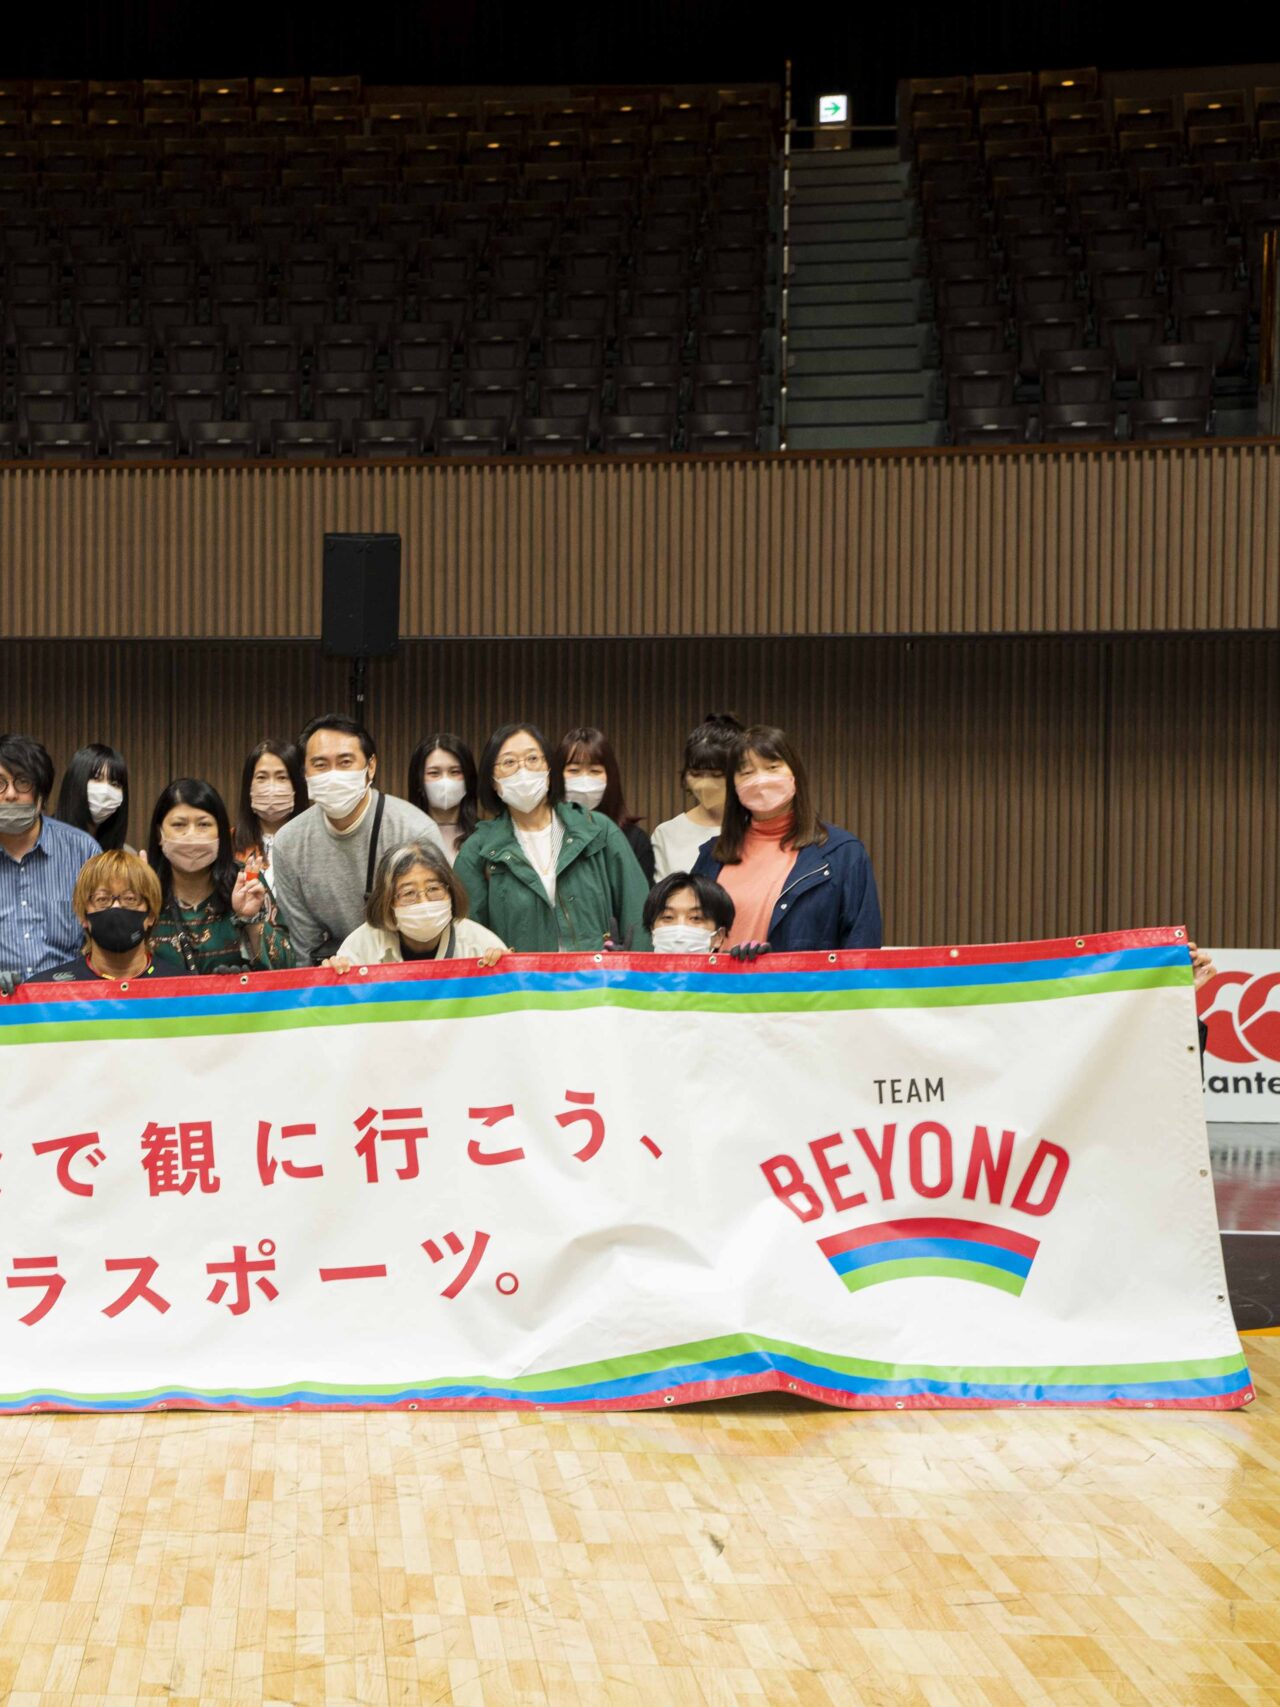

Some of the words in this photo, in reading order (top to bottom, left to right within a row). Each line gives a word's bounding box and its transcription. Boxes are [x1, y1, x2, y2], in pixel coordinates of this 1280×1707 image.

[873, 1077, 946, 1105] TEAM
[1202, 1071, 1280, 1095] ante
[759, 1120, 1071, 1224] BEYOND
